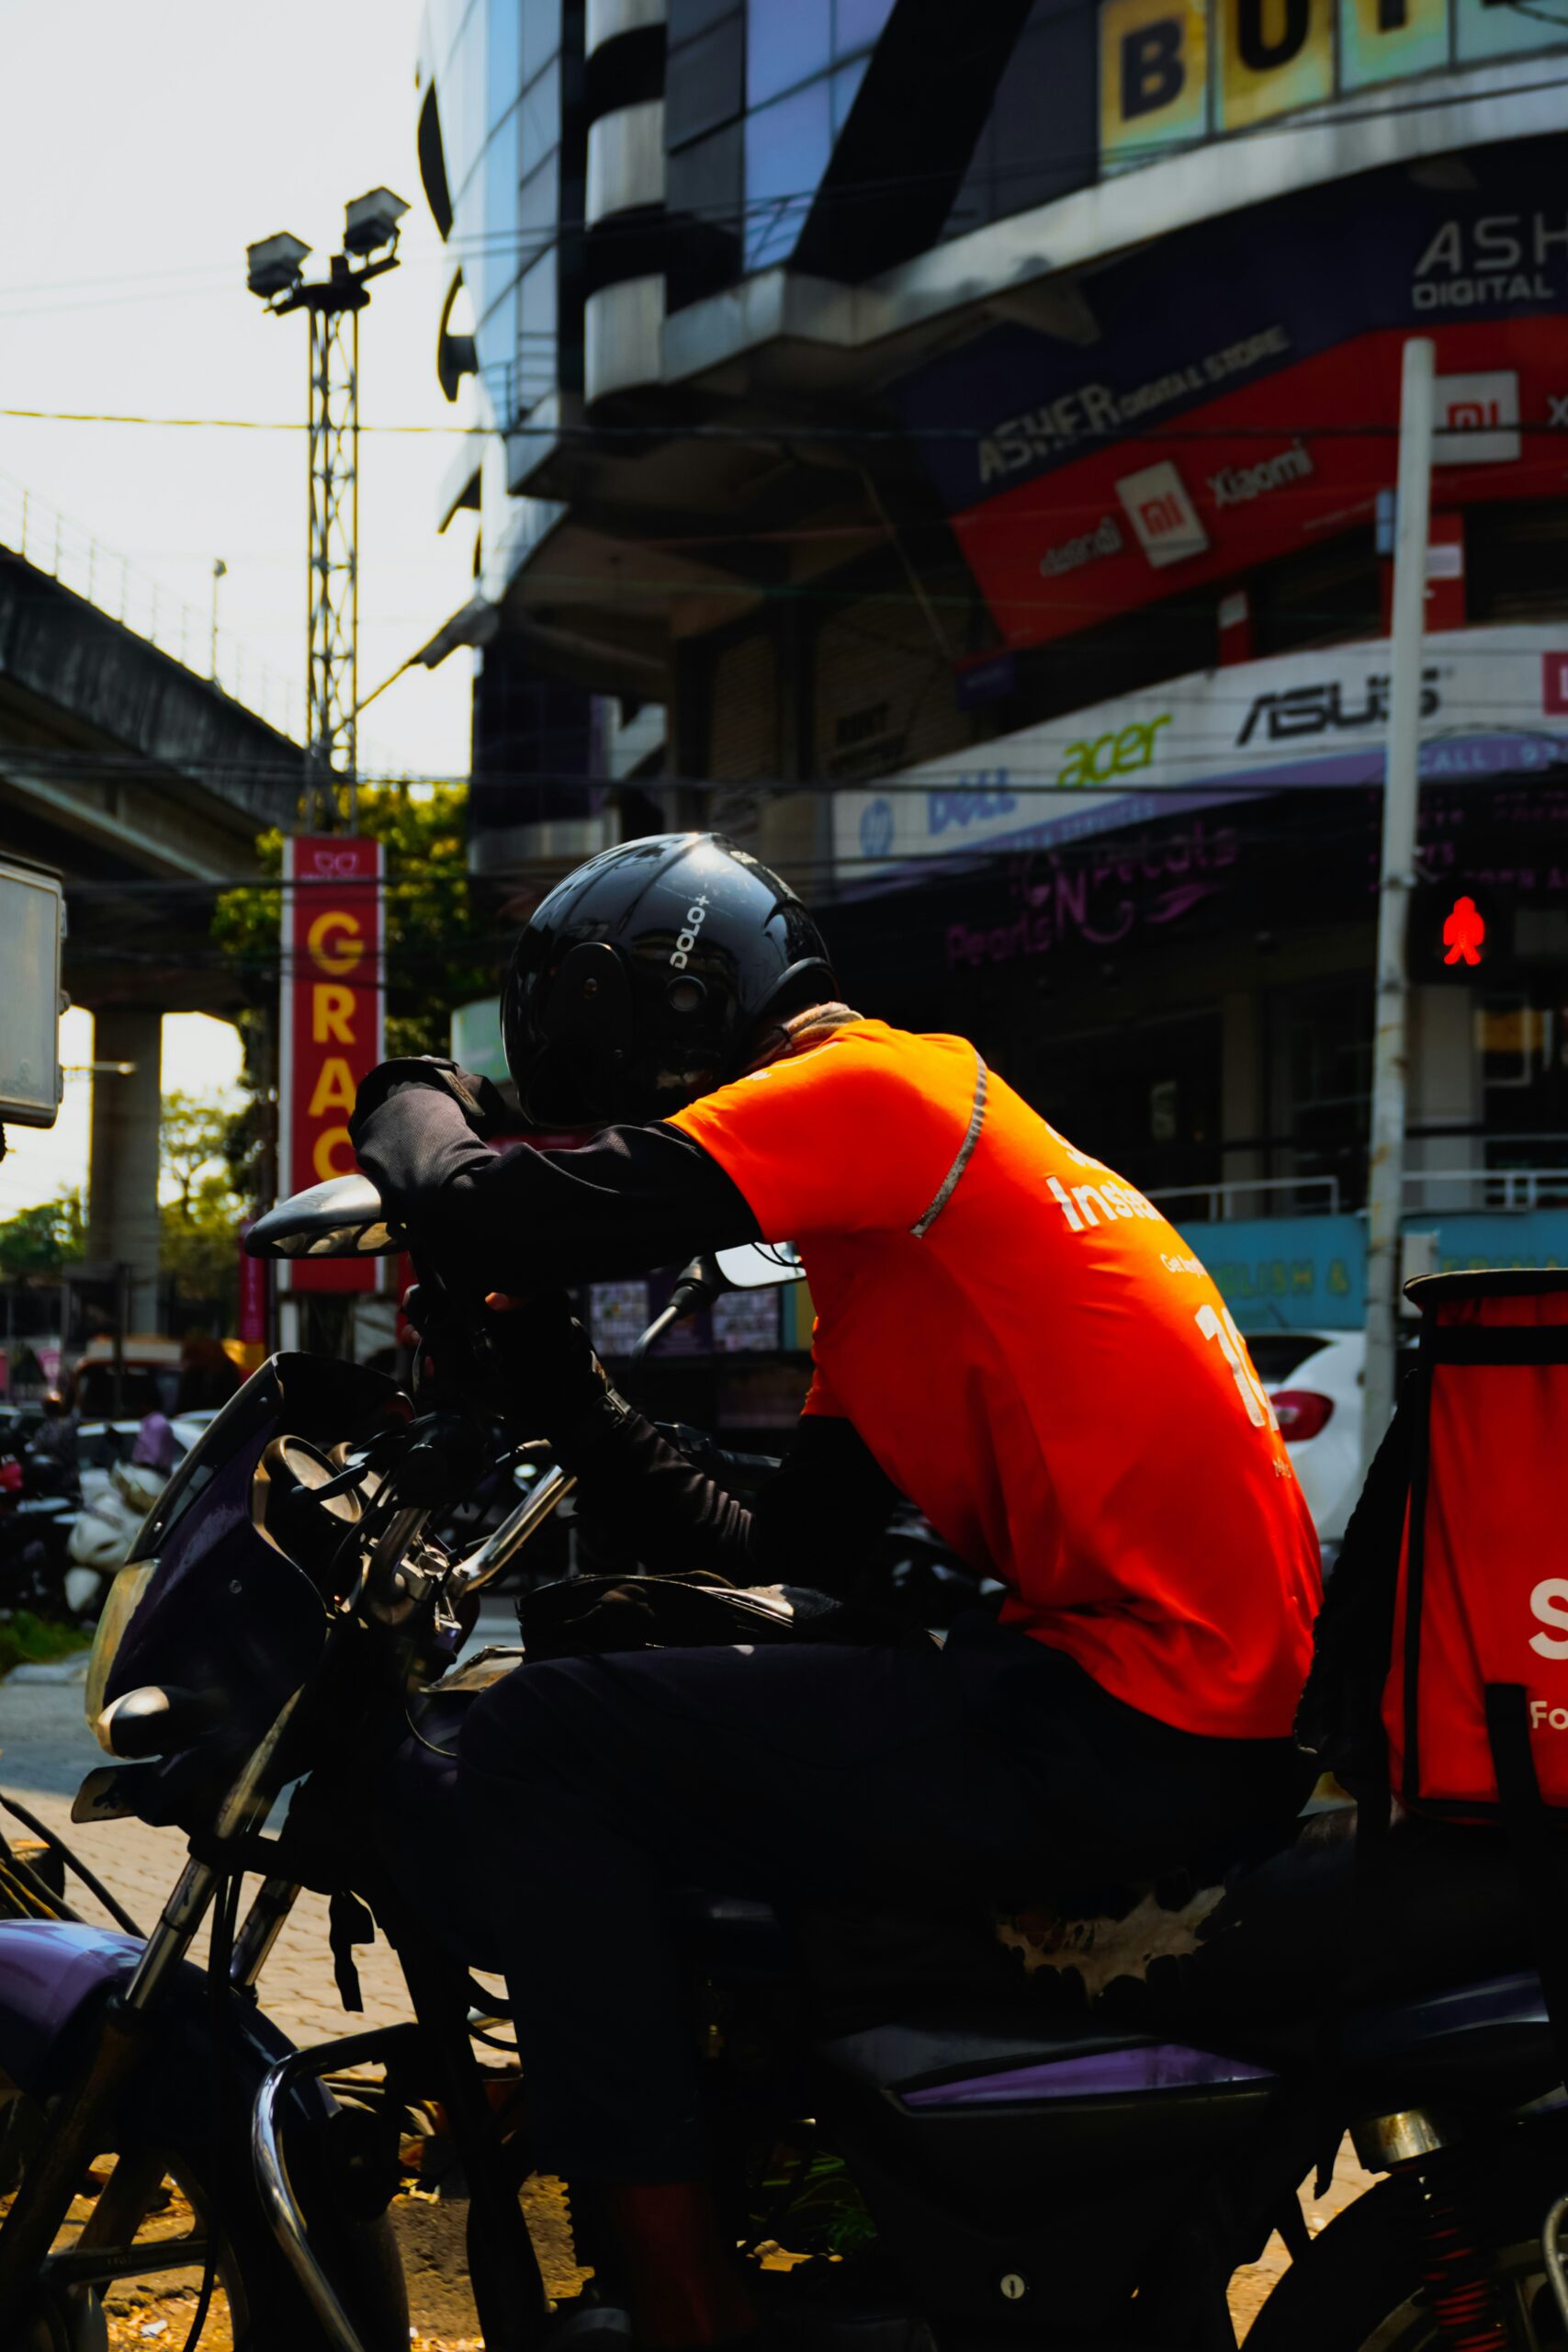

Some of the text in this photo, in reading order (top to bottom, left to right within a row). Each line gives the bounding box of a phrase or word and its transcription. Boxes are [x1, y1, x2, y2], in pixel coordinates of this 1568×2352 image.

[1412, 273, 1554, 311] DIGITAL
[977, 382, 1122, 485] ASHER
[1205, 436, 1314, 511] Xiaomi
[1056, 713, 1172, 787] acer
[928, 768, 1017, 833] DELL
[945, 912, 1053, 968] Pearls
[1530, 1701, 1568, 1730] Fo
